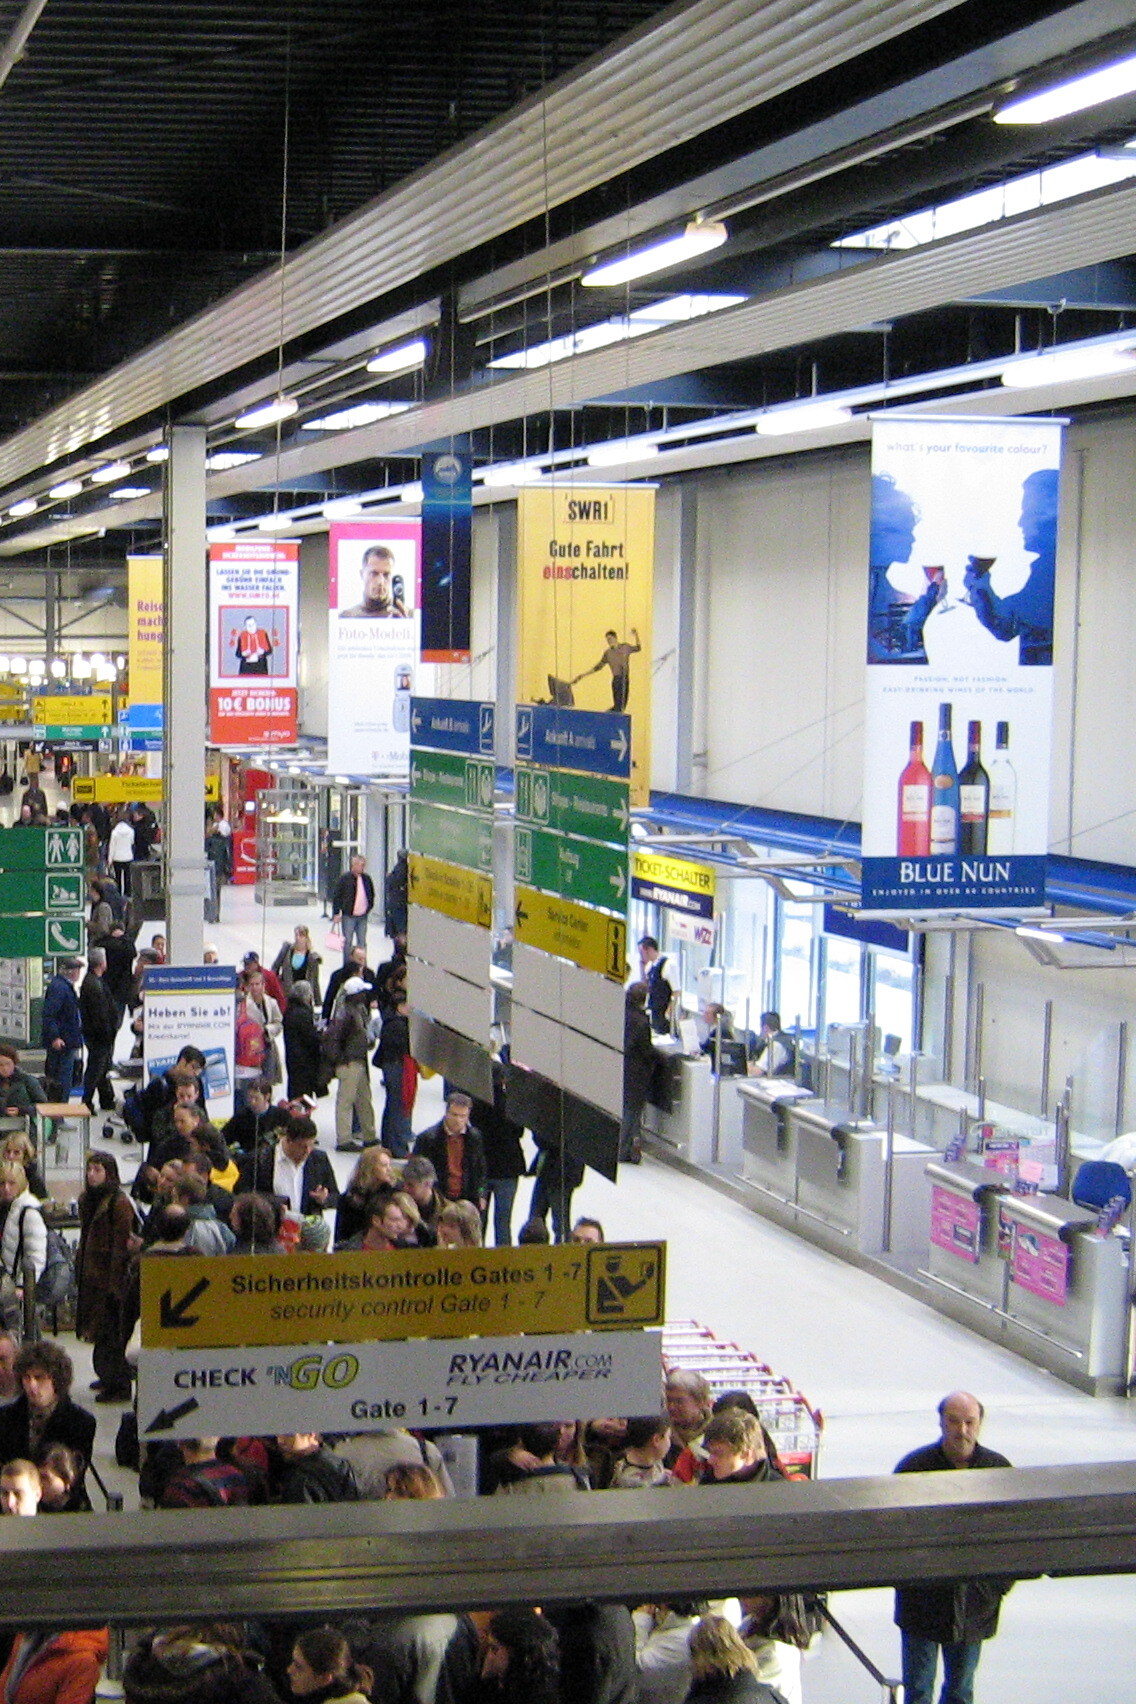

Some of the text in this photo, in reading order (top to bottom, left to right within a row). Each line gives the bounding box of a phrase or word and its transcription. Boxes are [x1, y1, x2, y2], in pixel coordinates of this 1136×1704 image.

[926, 444, 952, 454] your
[955, 443, 1004, 454] favourite
[1007, 445, 1048, 454] colour?
[568, 501, 608, 520] SWR1
[549, 540, 624, 558] Gute Fahrt
[543, 562, 629, 580] einschalten!
[246, 697, 291, 711] BONUS
[635, 857, 711, 889] TICKET-SCHALTER
[900, 861, 1010, 883] BLUE NUN
[148, 1006, 230, 1017] Heben Sie ab!
[231, 1266, 462, 1294] Sicherheitskontrolle
[470, 1265, 535, 1286] Gates
[270, 1300, 354, 1322] security
[361, 1294, 434, 1317] control
[441, 1293, 491, 1313] Gate
[174, 1367, 257, 1389] CHECK
[446, 1369, 612, 1386] FLY CHEAPER
[351, 1399, 405, 1419] Gate
